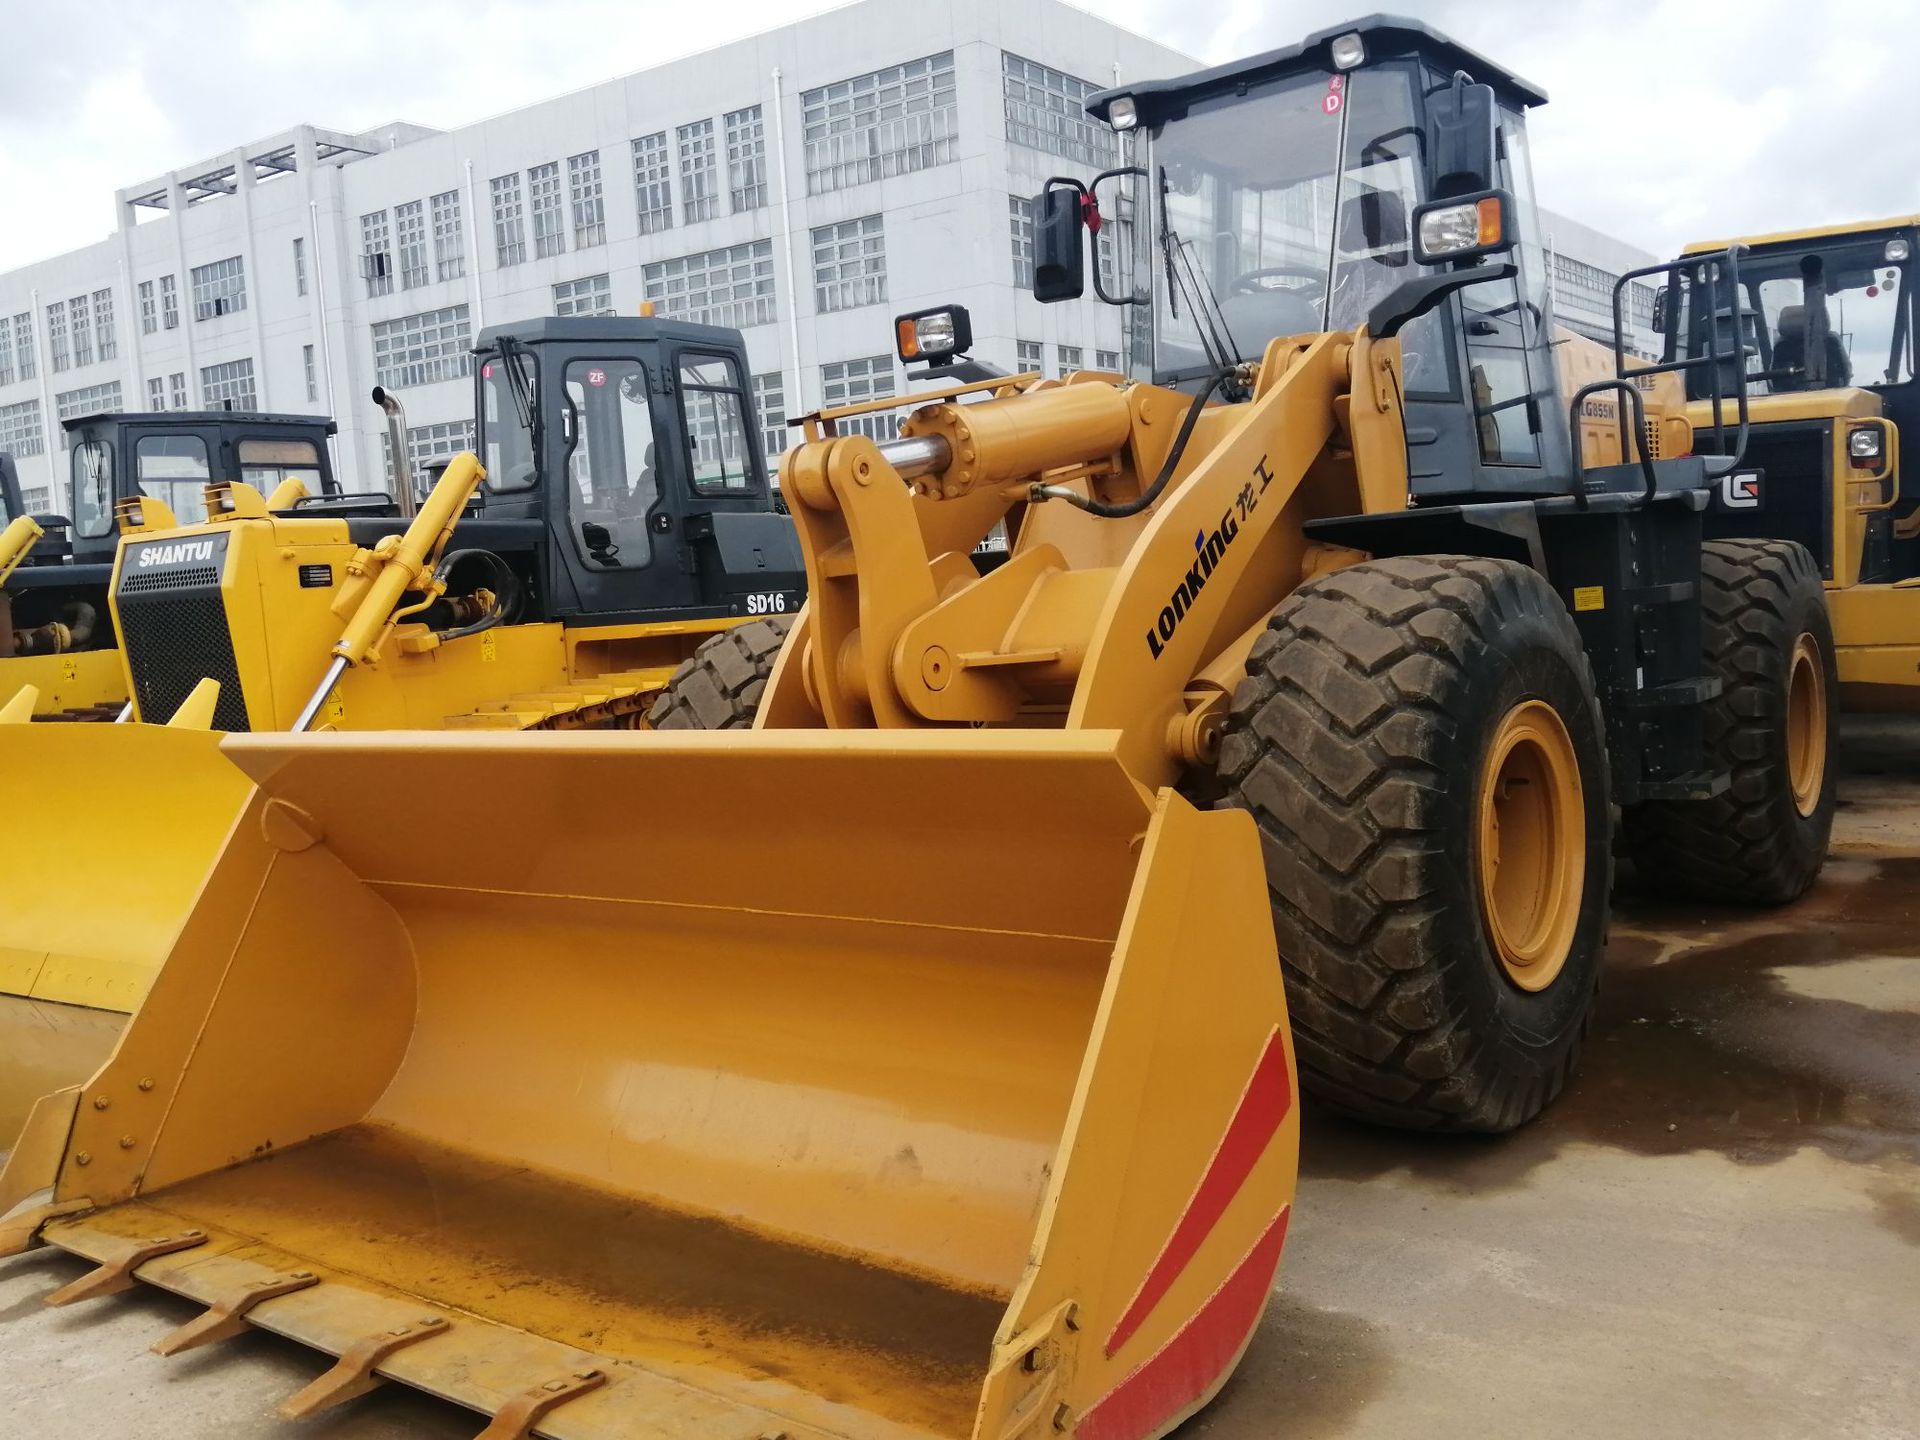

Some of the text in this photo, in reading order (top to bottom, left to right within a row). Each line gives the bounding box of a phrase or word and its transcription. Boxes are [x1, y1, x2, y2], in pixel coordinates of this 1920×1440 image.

[1327, 95, 1338, 111] D
[139, 541, 213, 567] SHANTUI
[747, 593, 785, 614] SD16
